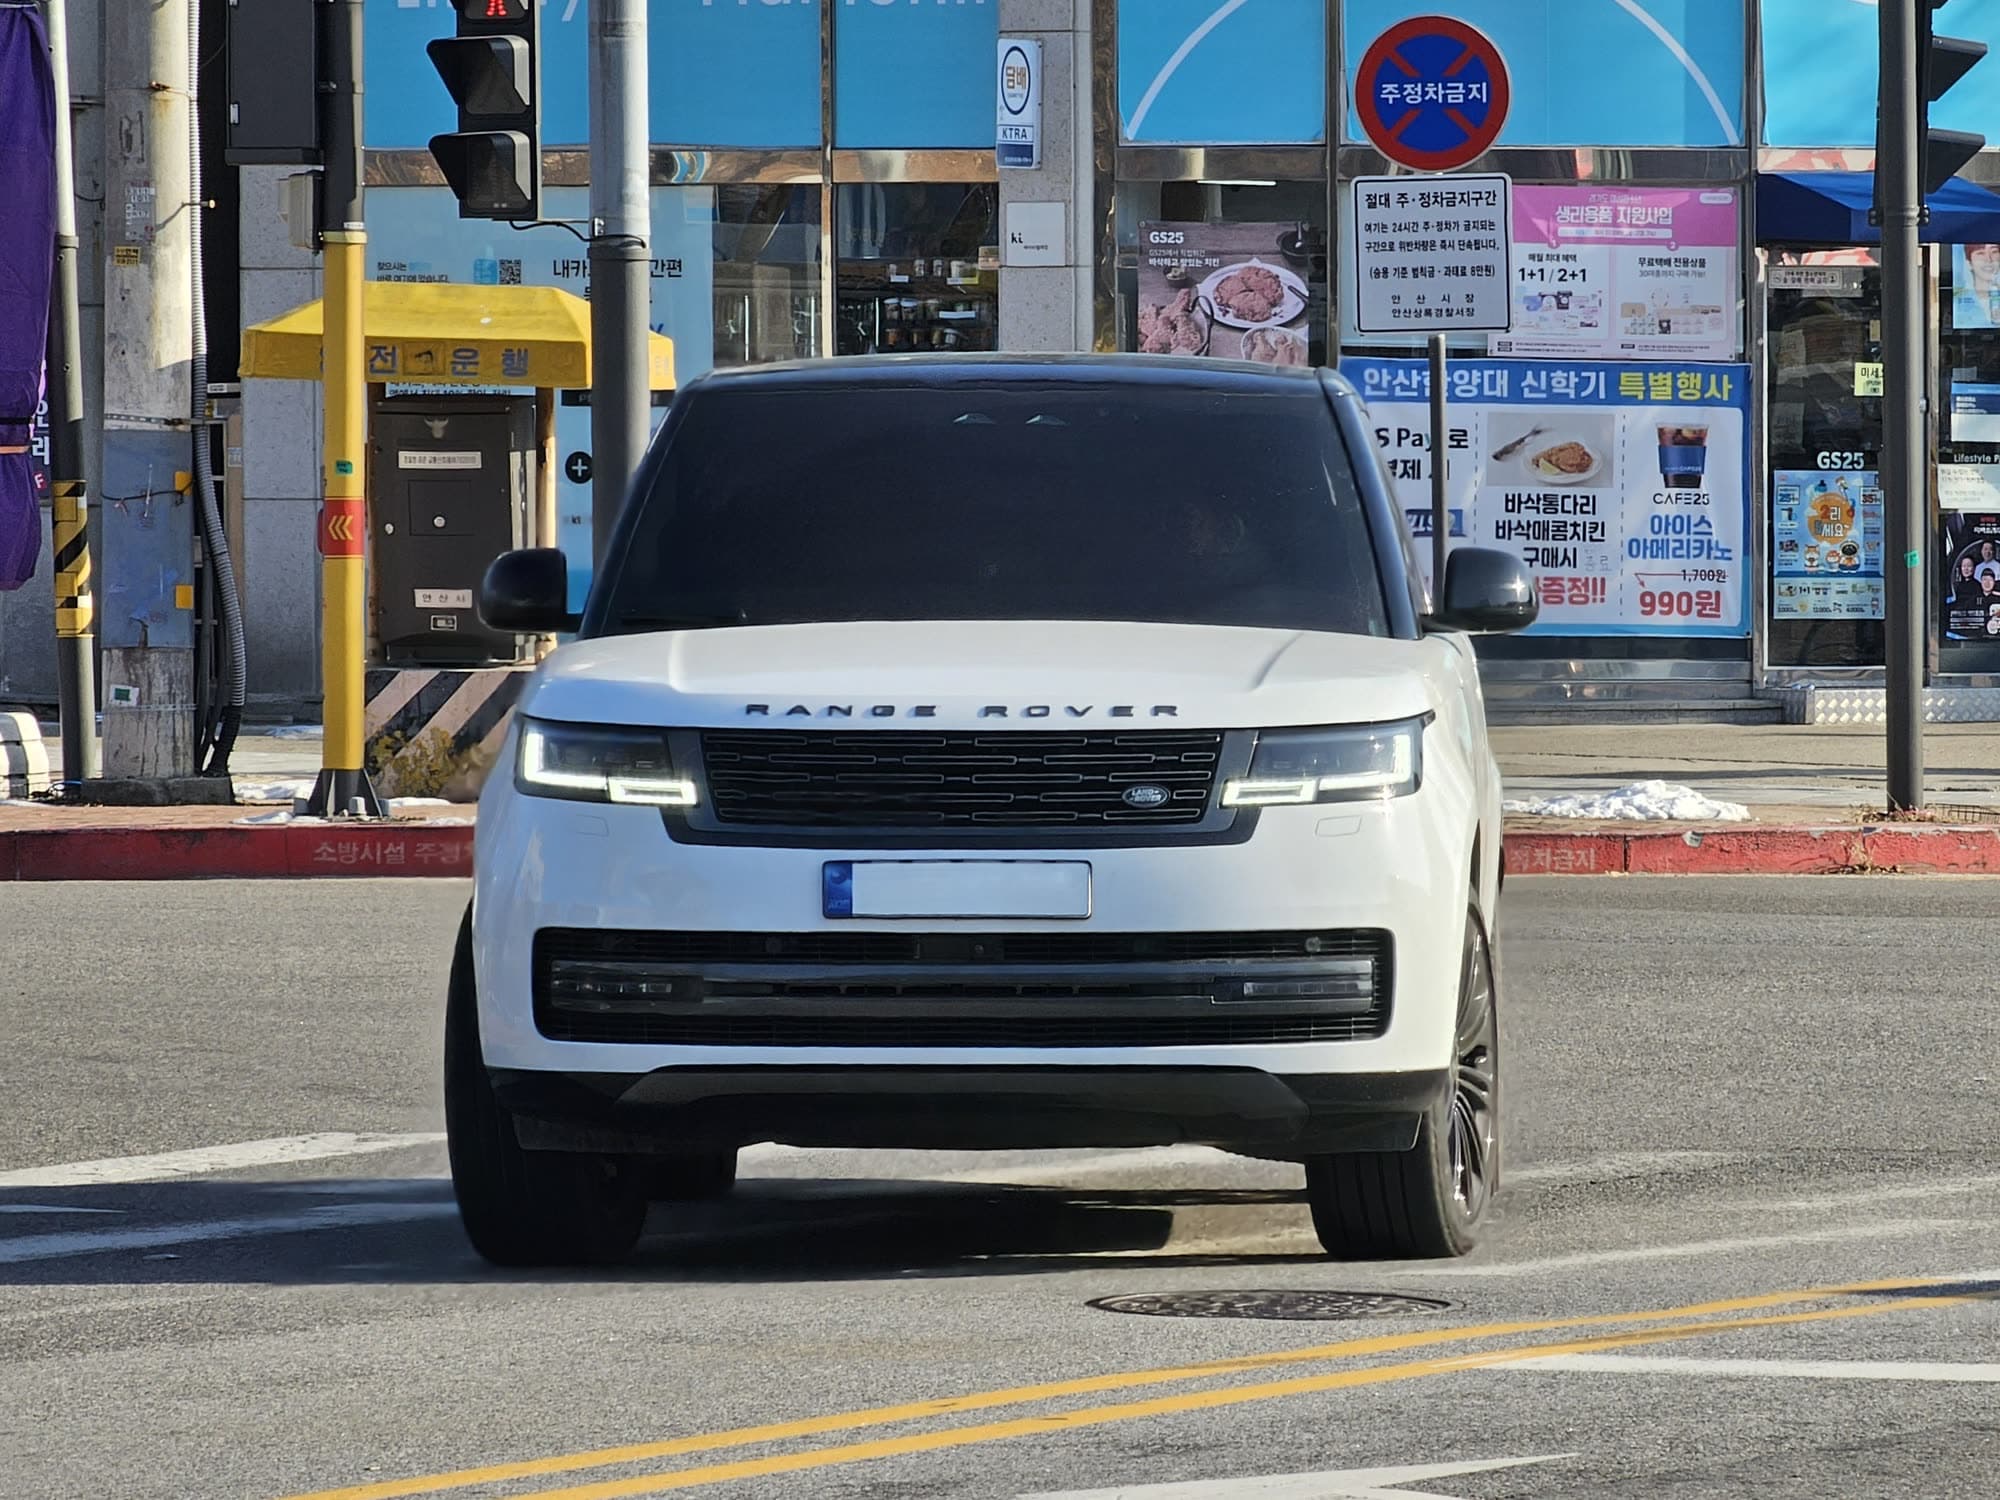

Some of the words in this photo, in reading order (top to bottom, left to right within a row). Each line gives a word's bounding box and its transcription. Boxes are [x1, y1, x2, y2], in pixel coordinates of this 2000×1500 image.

[1006, 66, 1026, 89] 담배
[1380, 82, 1488, 105] 주정차금지
[1002, 127, 1028, 140] KTRA
[1365, 192, 1391, 209] 절대
[1556, 206, 1613, 224] 생리용품
[1616, 206, 1673, 225] 지원사업
[1364, 222, 1389, 233] 여기는
[1392, 221, 1419, 233] 24시간
[1464, 219, 1496, 232] 금지되는
[1149, 231, 1185, 244] GS25
[1365, 241, 1395, 252] 구간으로
[1398, 240, 1438, 251] 위반차량은
[1440, 240, 1455, 250] 즉시
[1545, 253, 1561, 262] 최대
[553, 259, 591, 278] 내카
[1392, 266, 1409, 279] 기준
[1411, 265, 1436, 279] 범칙금
[1444, 265, 1468, 277] 과태료
[1518, 268, 1545, 282] 1+1
[1557, 268, 1587, 283] 2+1
[1391, 307, 1475, 318] 안산상록경찰서장
[1861, 367, 1884, 378] 미세
[1520, 369, 1606, 398] 신학기
[1619, 371, 1733, 401] 특별행사
[1817, 451, 1865, 470] GS25
[1953, 453, 1991, 464] Lifestyle
[1504, 492, 1597, 517] 바삭통다리
[1652, 493, 1710, 506] CAFE25
[1494, 519, 1606, 543] 바삭매콤치킨
[1650, 513, 1714, 536] 아이스
[1522, 546, 1577, 570] 구매시
[1627, 537, 1734, 562] 아메리카노
[1681, 568, 1727, 585] 1,700원
[1639, 589, 1722, 619] 990원
[746, 703, 938, 718] RANGE
[983, 704, 1179, 718] ROVER
[313, 841, 406, 865] 소방시설
[415, 841, 474, 865] 주정
